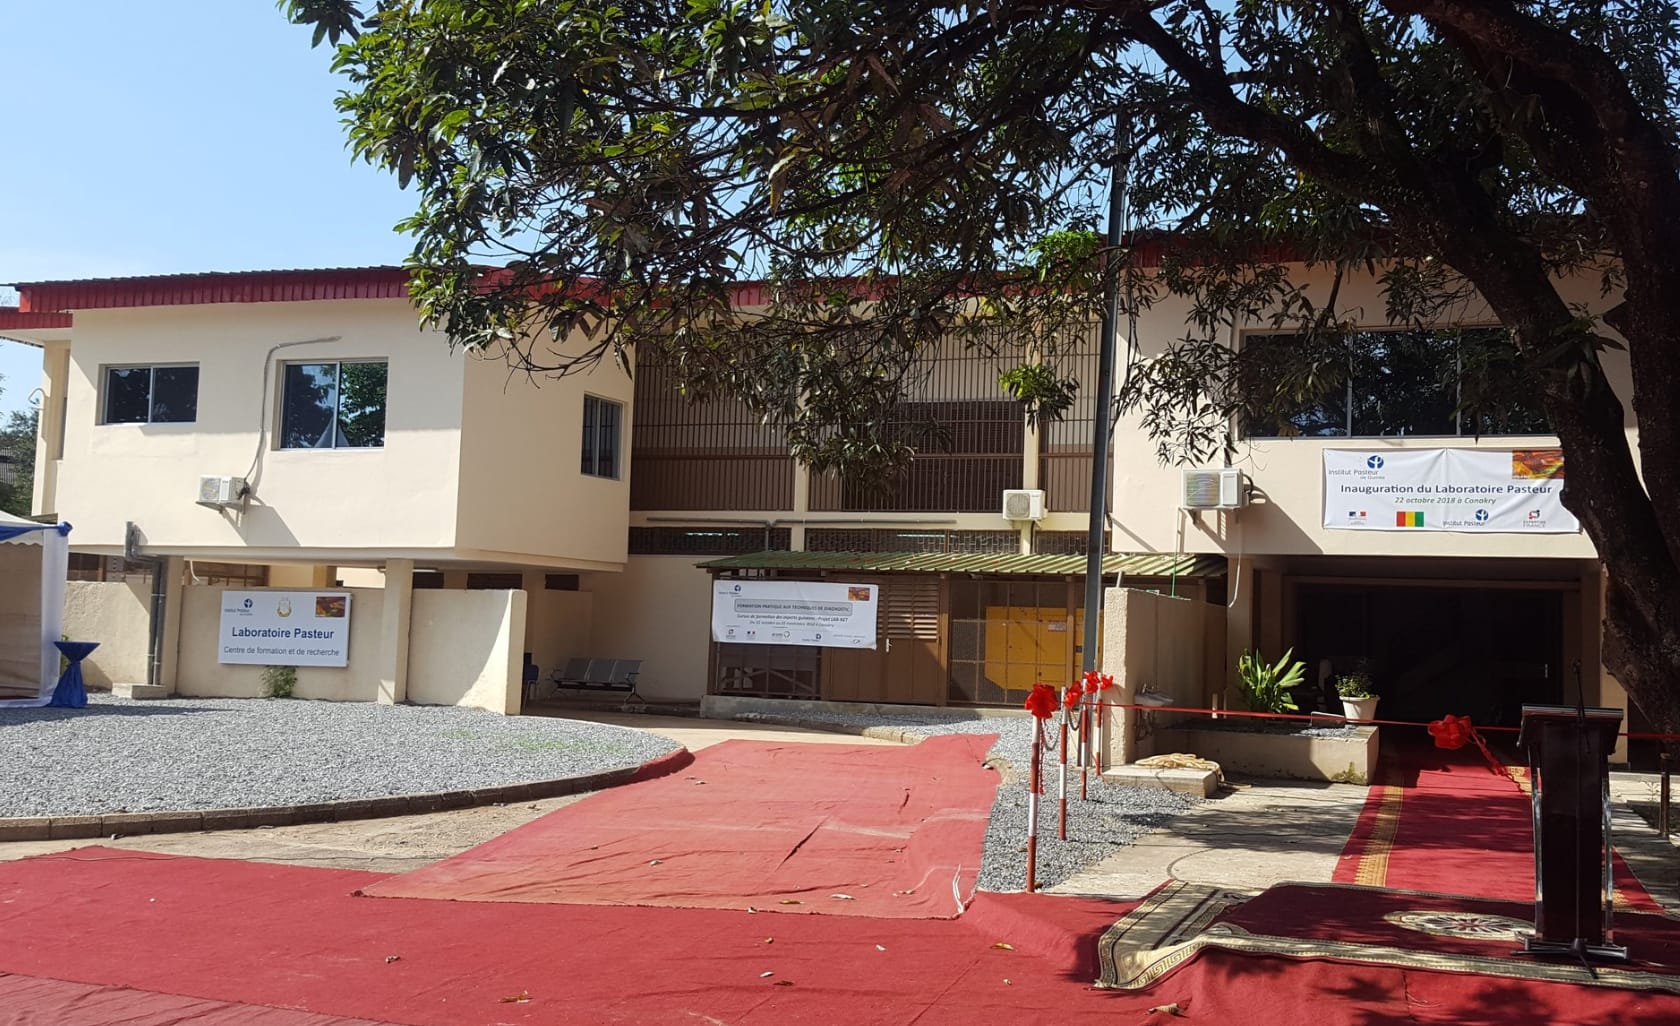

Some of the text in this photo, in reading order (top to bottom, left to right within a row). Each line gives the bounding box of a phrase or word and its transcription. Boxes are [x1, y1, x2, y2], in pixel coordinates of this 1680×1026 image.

[1341, 484, 1552, 495] Inauguration du Laboratoire Pasteur
[1464, 497, 1496, 505] Conakry
[232, 627, 334, 639] Laboratoire Pasteur
[257, 647, 287, 655] formation
[307, 648, 339, 656] recherche
